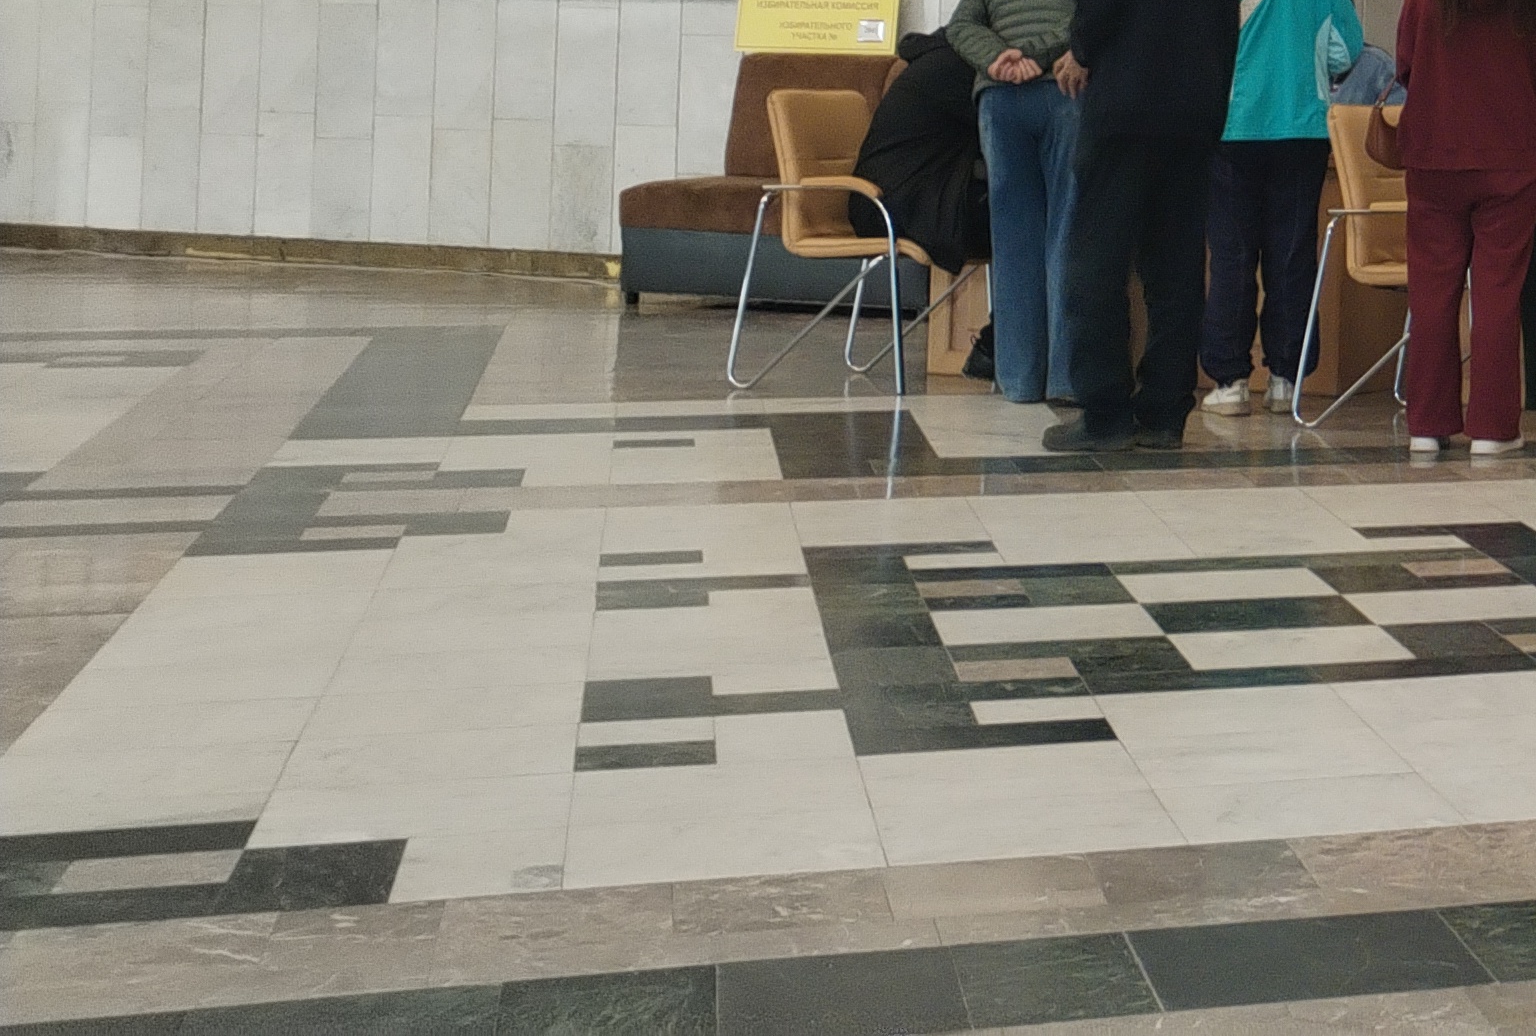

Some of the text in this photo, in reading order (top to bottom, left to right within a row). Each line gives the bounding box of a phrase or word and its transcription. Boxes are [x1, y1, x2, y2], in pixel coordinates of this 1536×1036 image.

[757, 0, 879, 10] ИЗБИРАТЕЛЬНАЯ КОМИССИЯ
[779, 21, 852, 30] ИЗБИРАТЕЛЬНОГО
